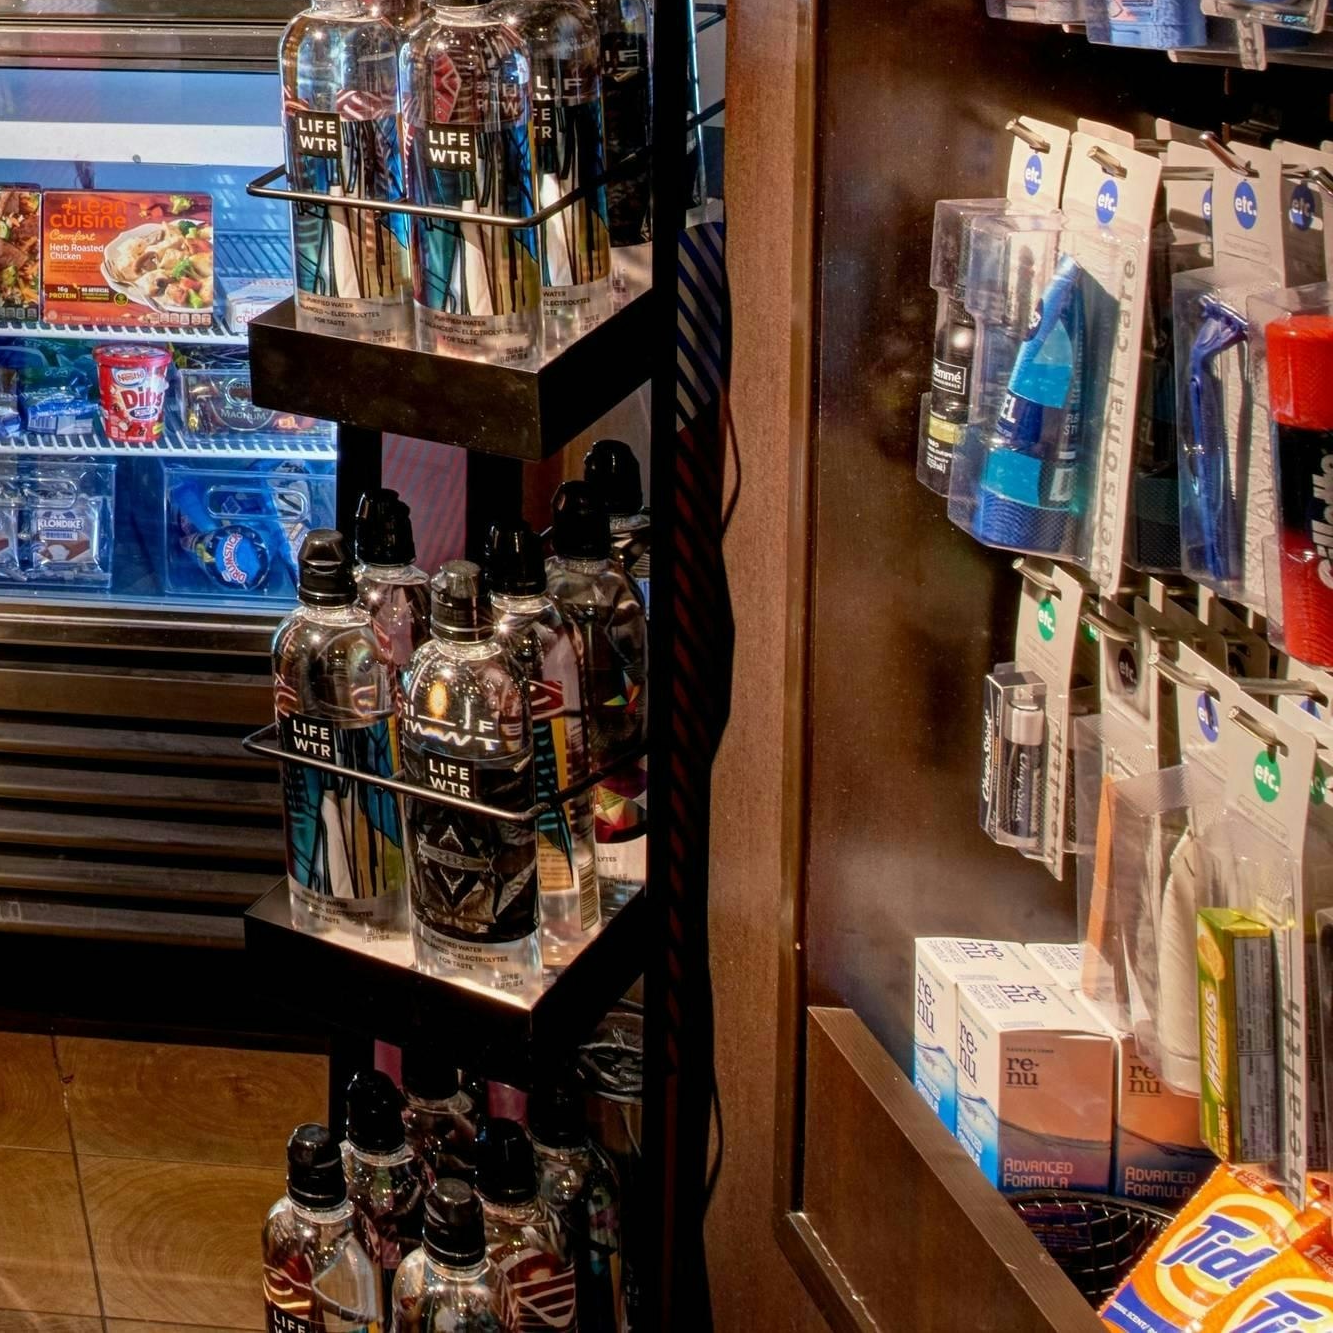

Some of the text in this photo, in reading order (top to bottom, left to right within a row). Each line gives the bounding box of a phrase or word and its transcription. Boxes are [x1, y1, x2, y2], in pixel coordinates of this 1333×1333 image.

[298, 116, 337, 134] LIFE
[299, 135, 338, 153] WTR
[428, 128, 471, 147] LIFE
[429, 147, 472, 165] WTR
[1024, 167, 1042, 184] etc.
[77, 200, 127, 214] Lean
[1097, 192, 1117, 212] etc.
[1234, 195, 1258, 216] etc.
[49, 213, 127, 228] cuisine
[48, 228, 95, 242] Comfort
[49, 243, 104, 252] Herb Roasted
[1120, 258, 1136, 368] care
[123, 386, 165, 413] Dibs
[37, 516, 85, 530] KLONDIKE
[220, 532, 248, 584] DRUMSTICK
[1037, 608, 1055, 632] etc.
[293, 719, 330, 740] LIFE
[293, 736, 332, 757] WTR
[429, 757, 470, 781] LIFE
[1254, 764, 1282, 792] etc.
[429, 776, 471, 798] WTR
[916, 995, 936, 1030] nu
[959, 1047, 979, 1084] nu
[1006, 1069, 1039, 1087] nu
[1129, 1078, 1163, 1095] nu
[1003, 1158, 1074, 1176] ADVANCED
[1125, 1168, 1197, 1185] ADVANCED
[1003, 1173, 1069, 1190] FORMULA
[1160, 1213, 1279, 1289] Tid
